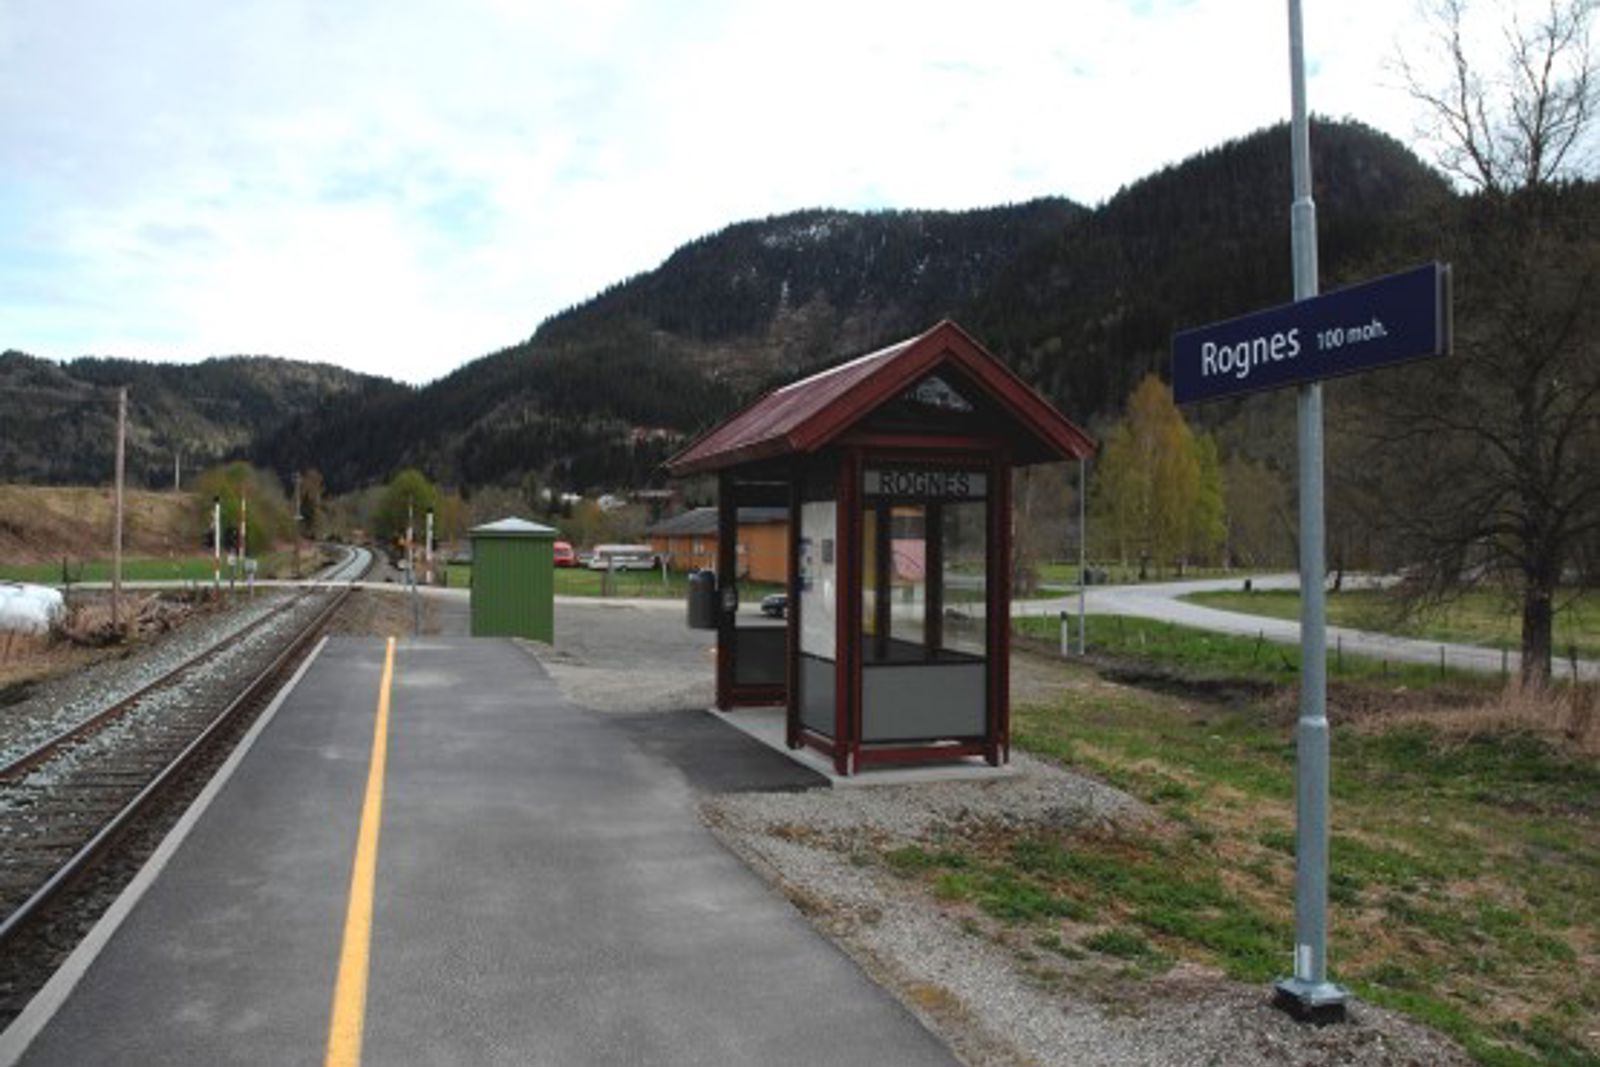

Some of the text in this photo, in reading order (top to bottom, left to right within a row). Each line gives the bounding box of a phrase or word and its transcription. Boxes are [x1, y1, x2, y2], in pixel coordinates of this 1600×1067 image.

[1201, 327, 1301, 379] Rognes
[1316, 328, 1344, 350] 100
[880, 471, 970, 496] ROGNES
